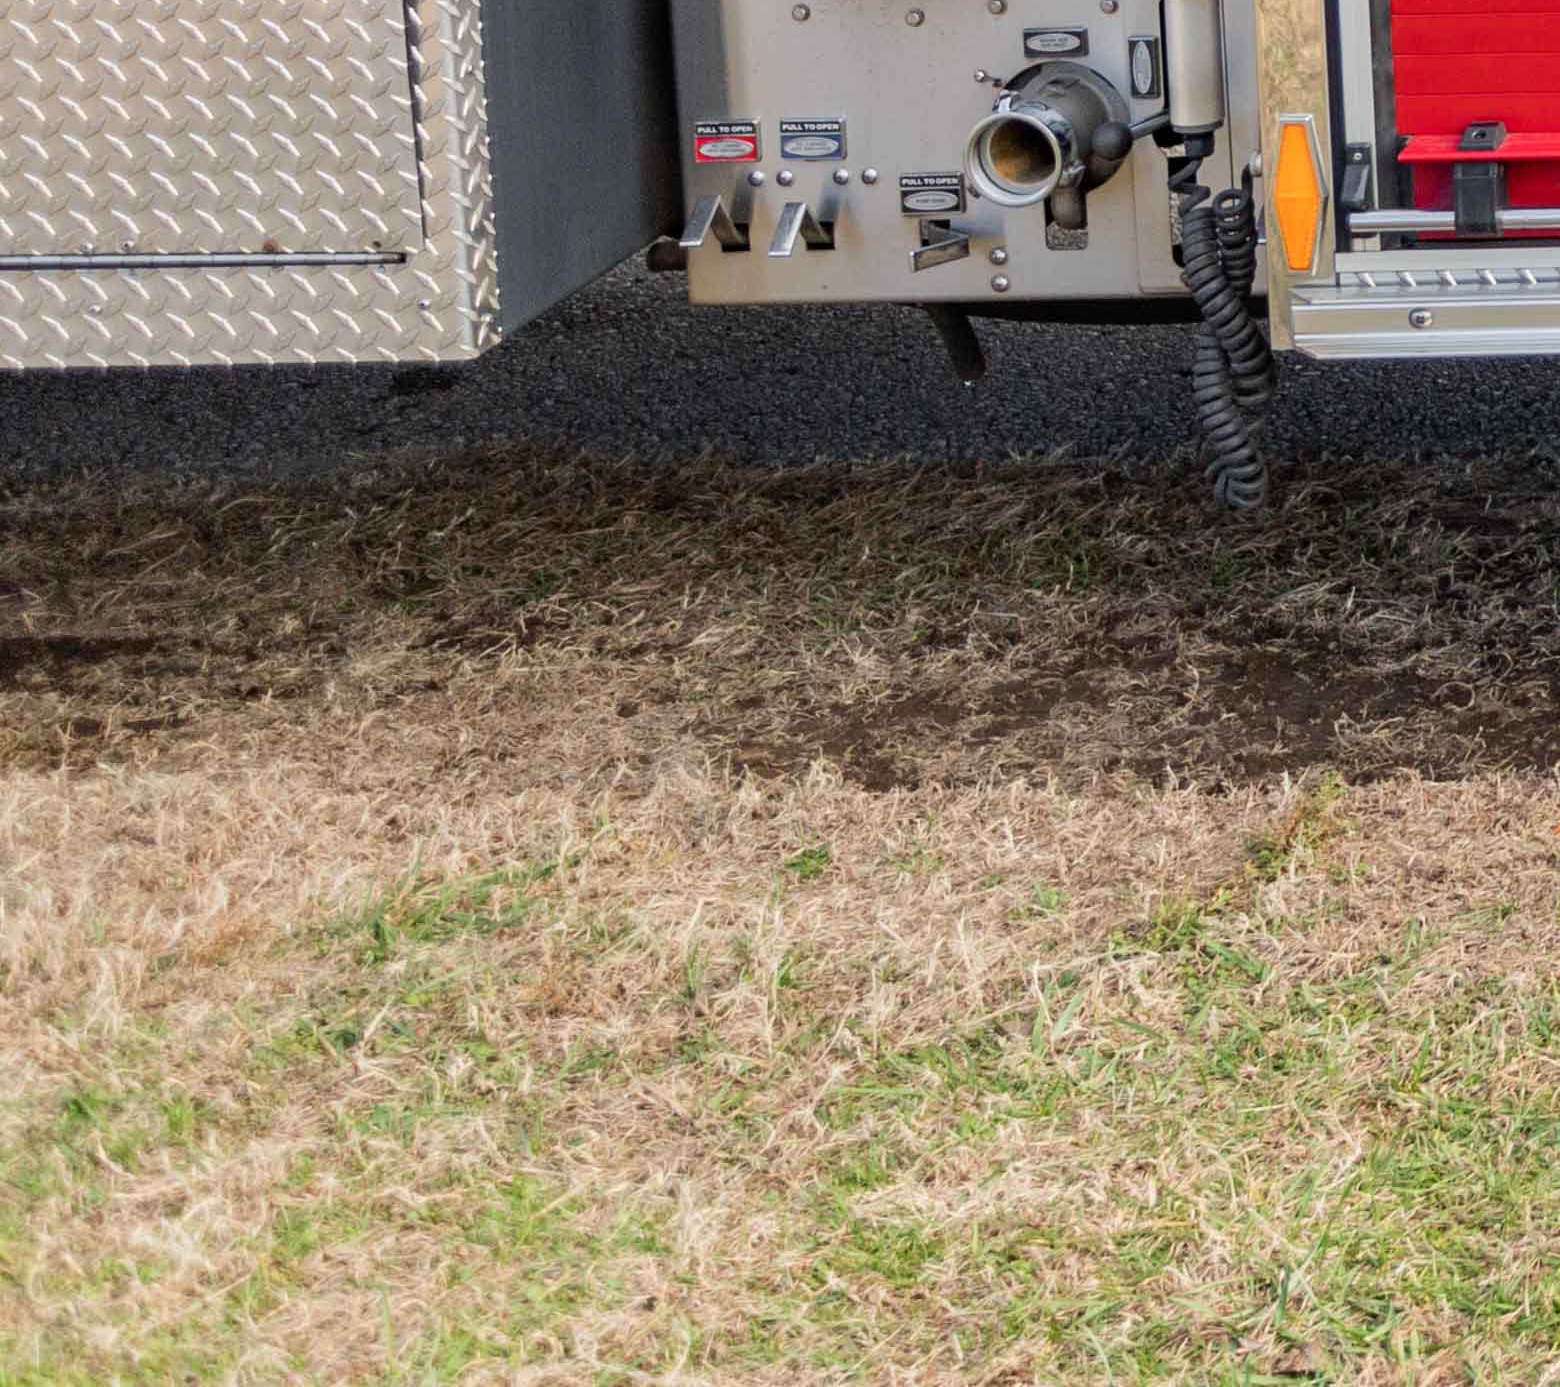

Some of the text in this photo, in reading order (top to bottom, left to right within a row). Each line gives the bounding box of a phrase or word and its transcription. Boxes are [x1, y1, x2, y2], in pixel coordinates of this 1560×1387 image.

[697, 126, 718, 134] PULL
[731, 125, 753, 133] OPEN
[782, 123, 839, 131] PULL TO OPEN
[902, 178, 923, 186] PULL
